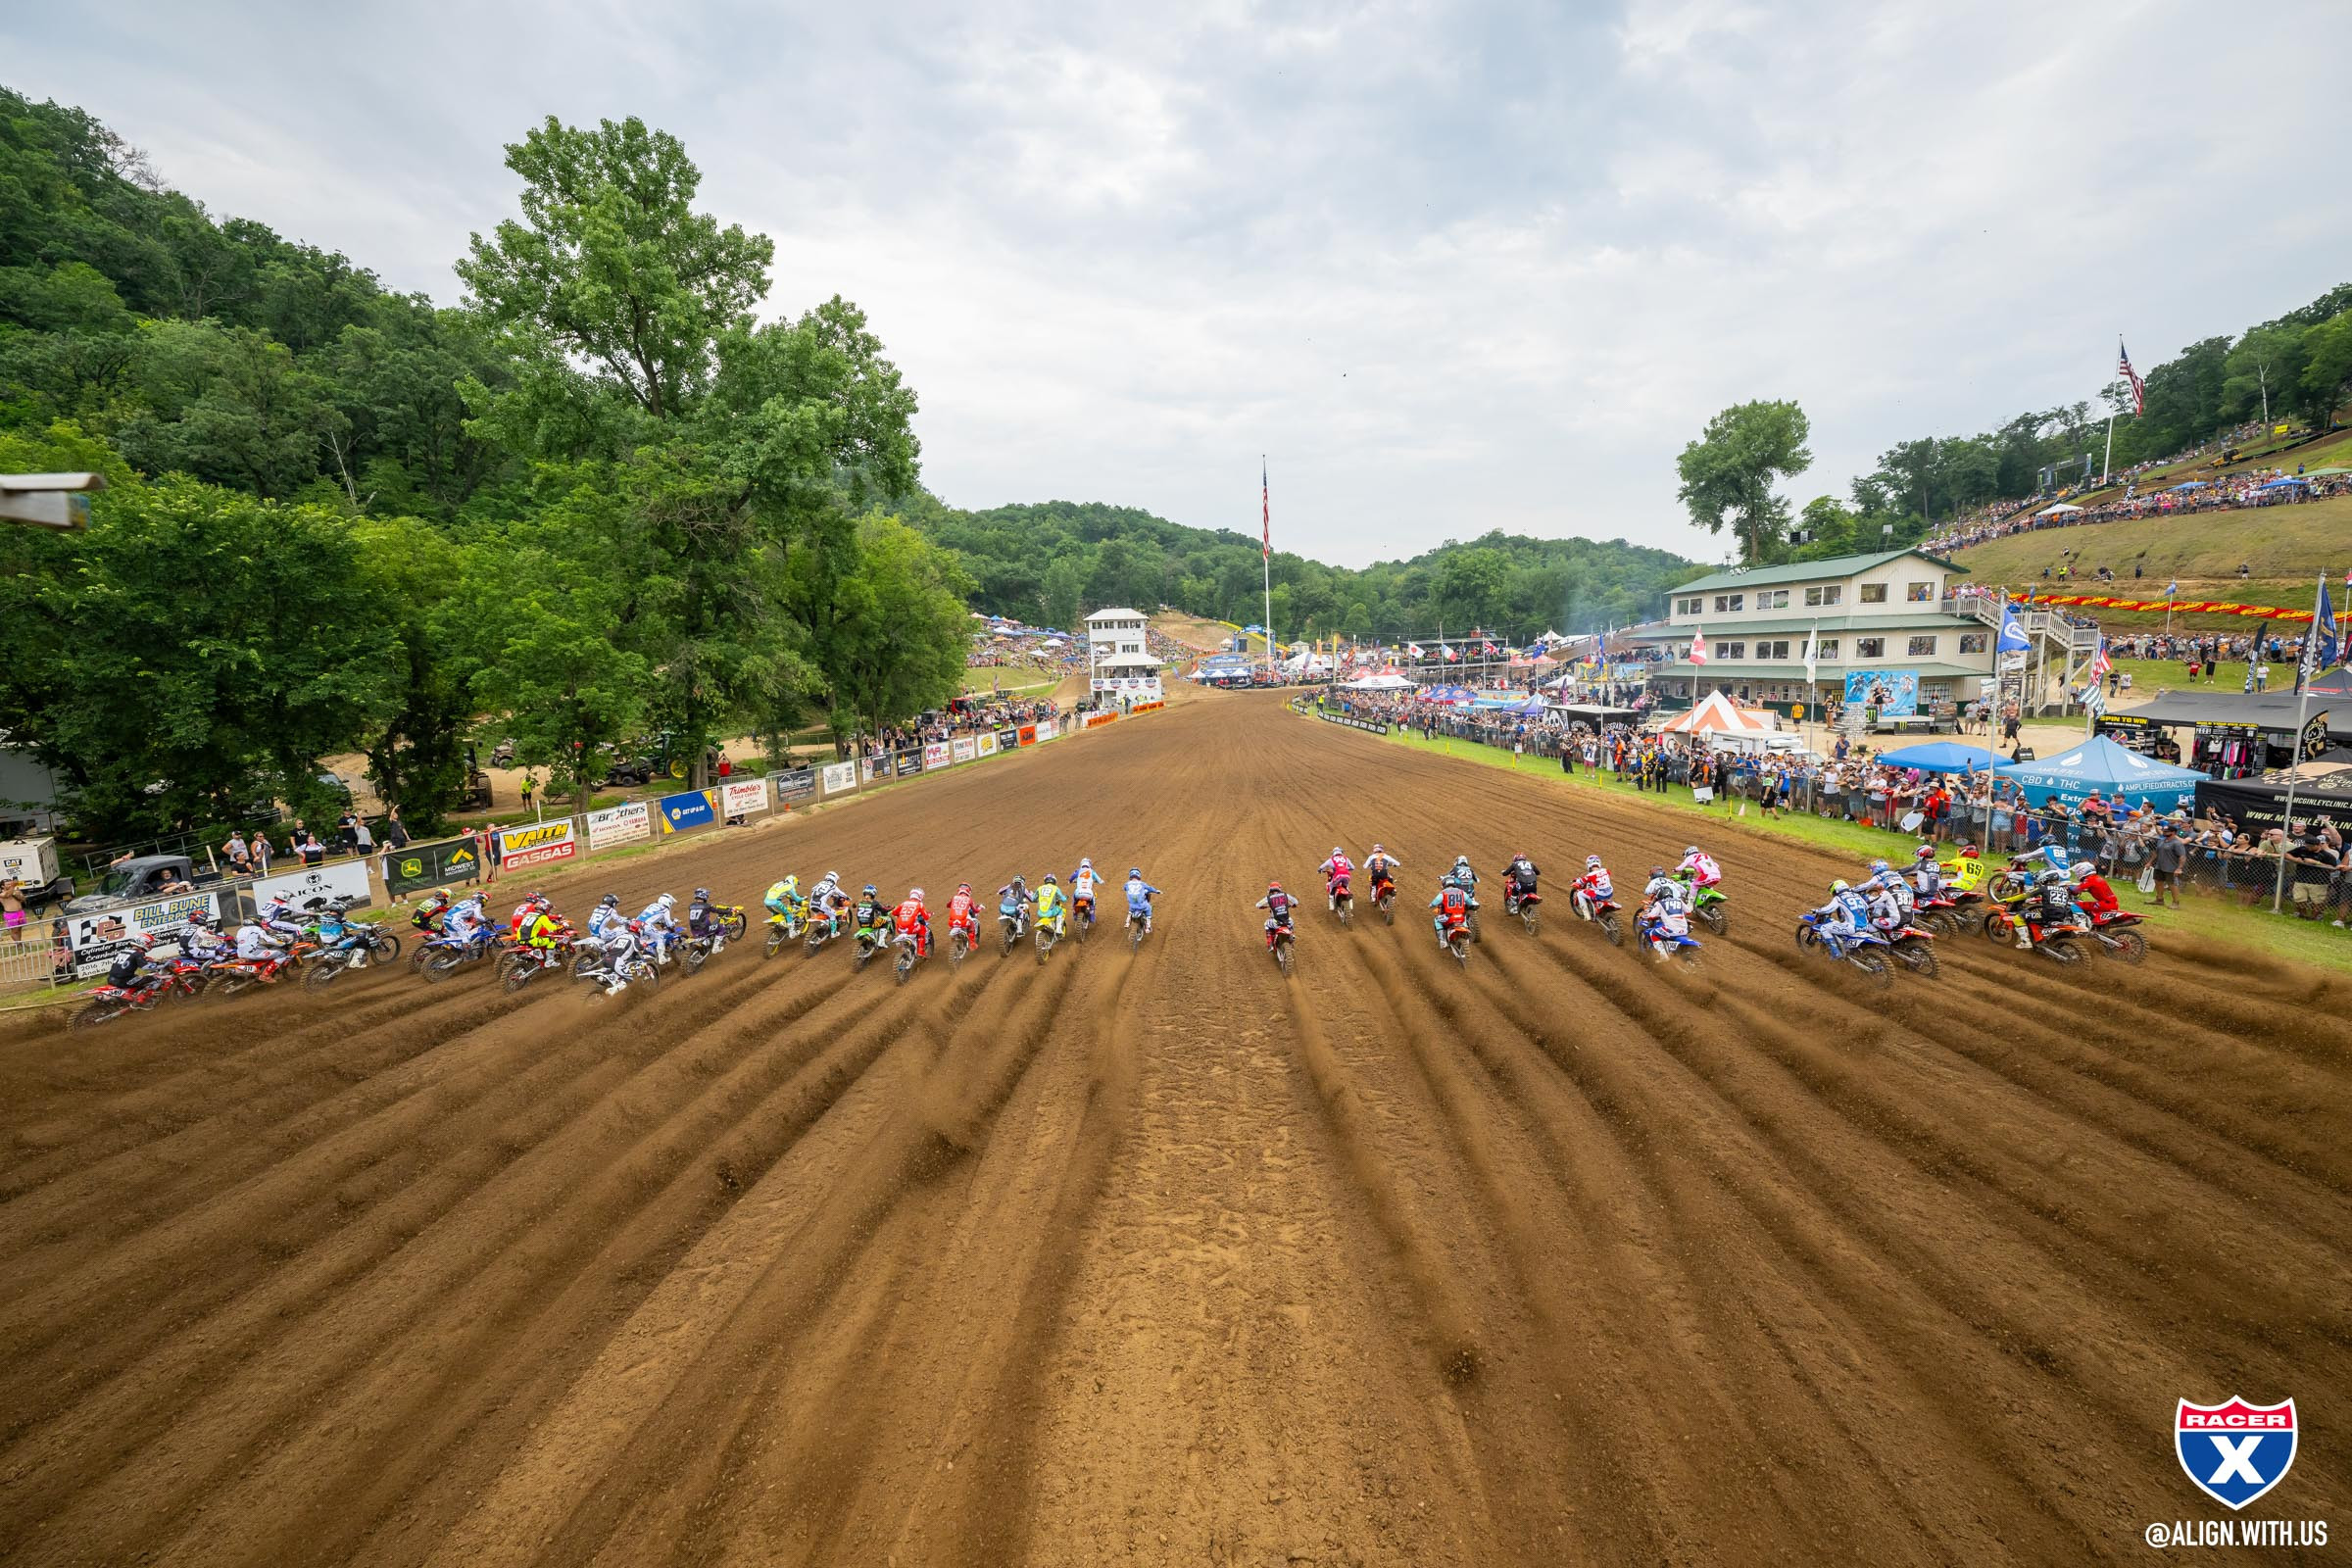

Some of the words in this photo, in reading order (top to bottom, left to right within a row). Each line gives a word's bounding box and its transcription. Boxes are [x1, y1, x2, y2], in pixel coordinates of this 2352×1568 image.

[2022, 775, 2042, 785] CBD
[2060, 779, 2081, 790] THC
[2125, 780, 2196, 792] AMPLIFIEDXTRACTS.CO
[729, 783, 761, 797] Trimble's
[504, 823, 569, 851] VAITH
[507, 845, 572, 869] GASGAS
[444, 860, 475, 872] MIDWEST
[1518, 861, 1533, 870] 14
[1080, 869, 1091, 879] 4
[1457, 869, 1473, 879] 28
[297, 884, 333, 897] ICON
[1041, 887, 1053, 897] 12
[1447, 894, 1463, 908] 84
[133, 904, 165, 922] BILL
[169, 895, 211, 913] BUNE
[689, 908, 703, 920] 87
[858, 907, 872, 917] 22
[80, 943, 113, 956] Cylinder
[80, 963, 98, 972] 2016
